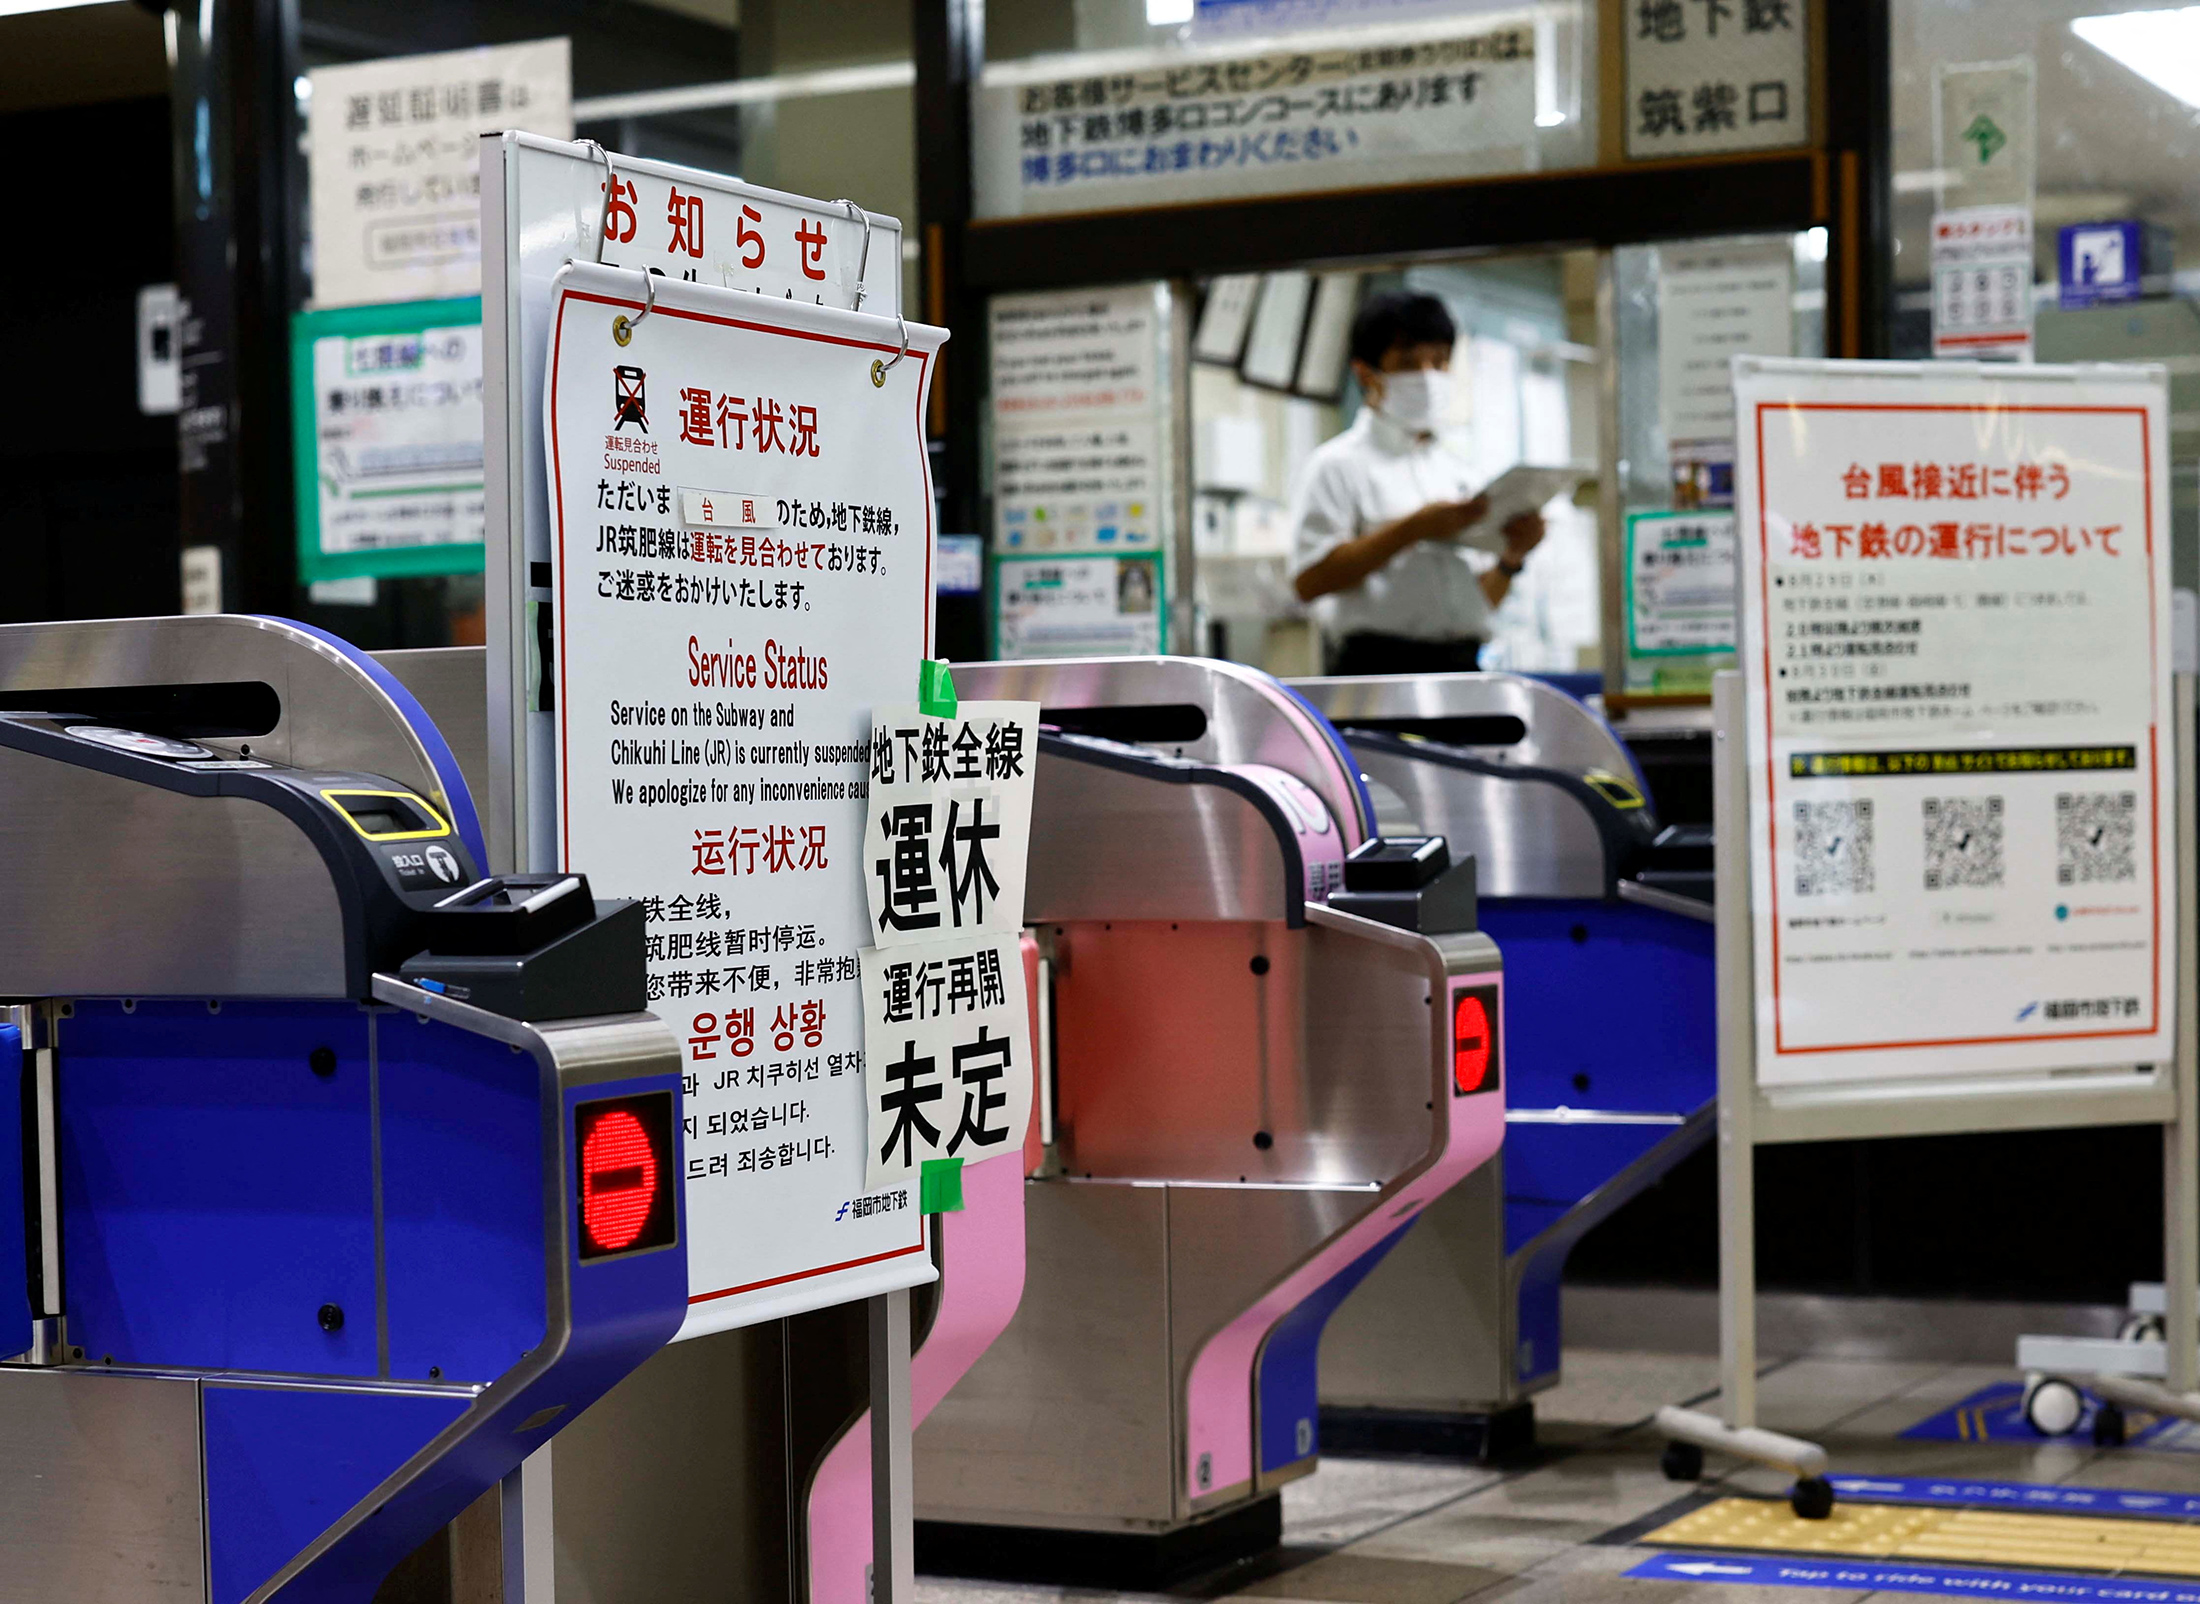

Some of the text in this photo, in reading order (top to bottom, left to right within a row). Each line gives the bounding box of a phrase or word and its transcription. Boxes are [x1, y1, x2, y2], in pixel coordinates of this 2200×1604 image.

[1637, 80, 1789, 137] 筑紫口
[601, 173, 828, 281] お知らせ
[679, 387, 821, 458] 運行状況
[604, 435, 658, 455] 運転見合わせ
[604, 453, 661, 475] Suspended
[597, 478, 672, 515] ただいま
[1840, 462, 2071, 502] 台風接近に伴う
[596, 523, 887, 577] JR筑肥線は運転を見合わせております。
[1790, 521, 2123, 561] 地下鉄の運行について
[597, 569, 812, 613] ご迷惑をおかけいたします。
[688, 635, 828, 691] Service Status
[610, 700, 795, 732] Service on the Subway and
[611, 738, 871, 767] Chikuhi Line (JR) is currently suspended
[871, 720, 1024, 785] 地下鉄全線
[612, 779, 636, 805] We
[639, 779, 707, 807] apologize
[711, 778, 729, 802] for
[733, 782, 754, 806] any
[760, 775, 845, 802] inconvenience
[691, 825, 829, 876] 运行状况
[876, 798, 1000, 933] 運休
[616, 893, 731, 923] 铁全线，
[646, 955, 862, 1001] 您带来不便，非常抱
[883, 948, 1006, 1024] 運行再開
[688, 999, 827, 1061] 운행 상황
[714, 1070, 740, 1090] JR
[746, 1057, 820, 1089] 치쿠히선
[827, 1050, 866, 1078] 열차
[880, 1025, 1012, 1168] 未定
[683, 1099, 810, 1140] 지 되었습니다.
[686, 1135, 836, 1180] 드려 죄송합니다.
[851, 1190, 909, 1220] 福岡市地下鉄
